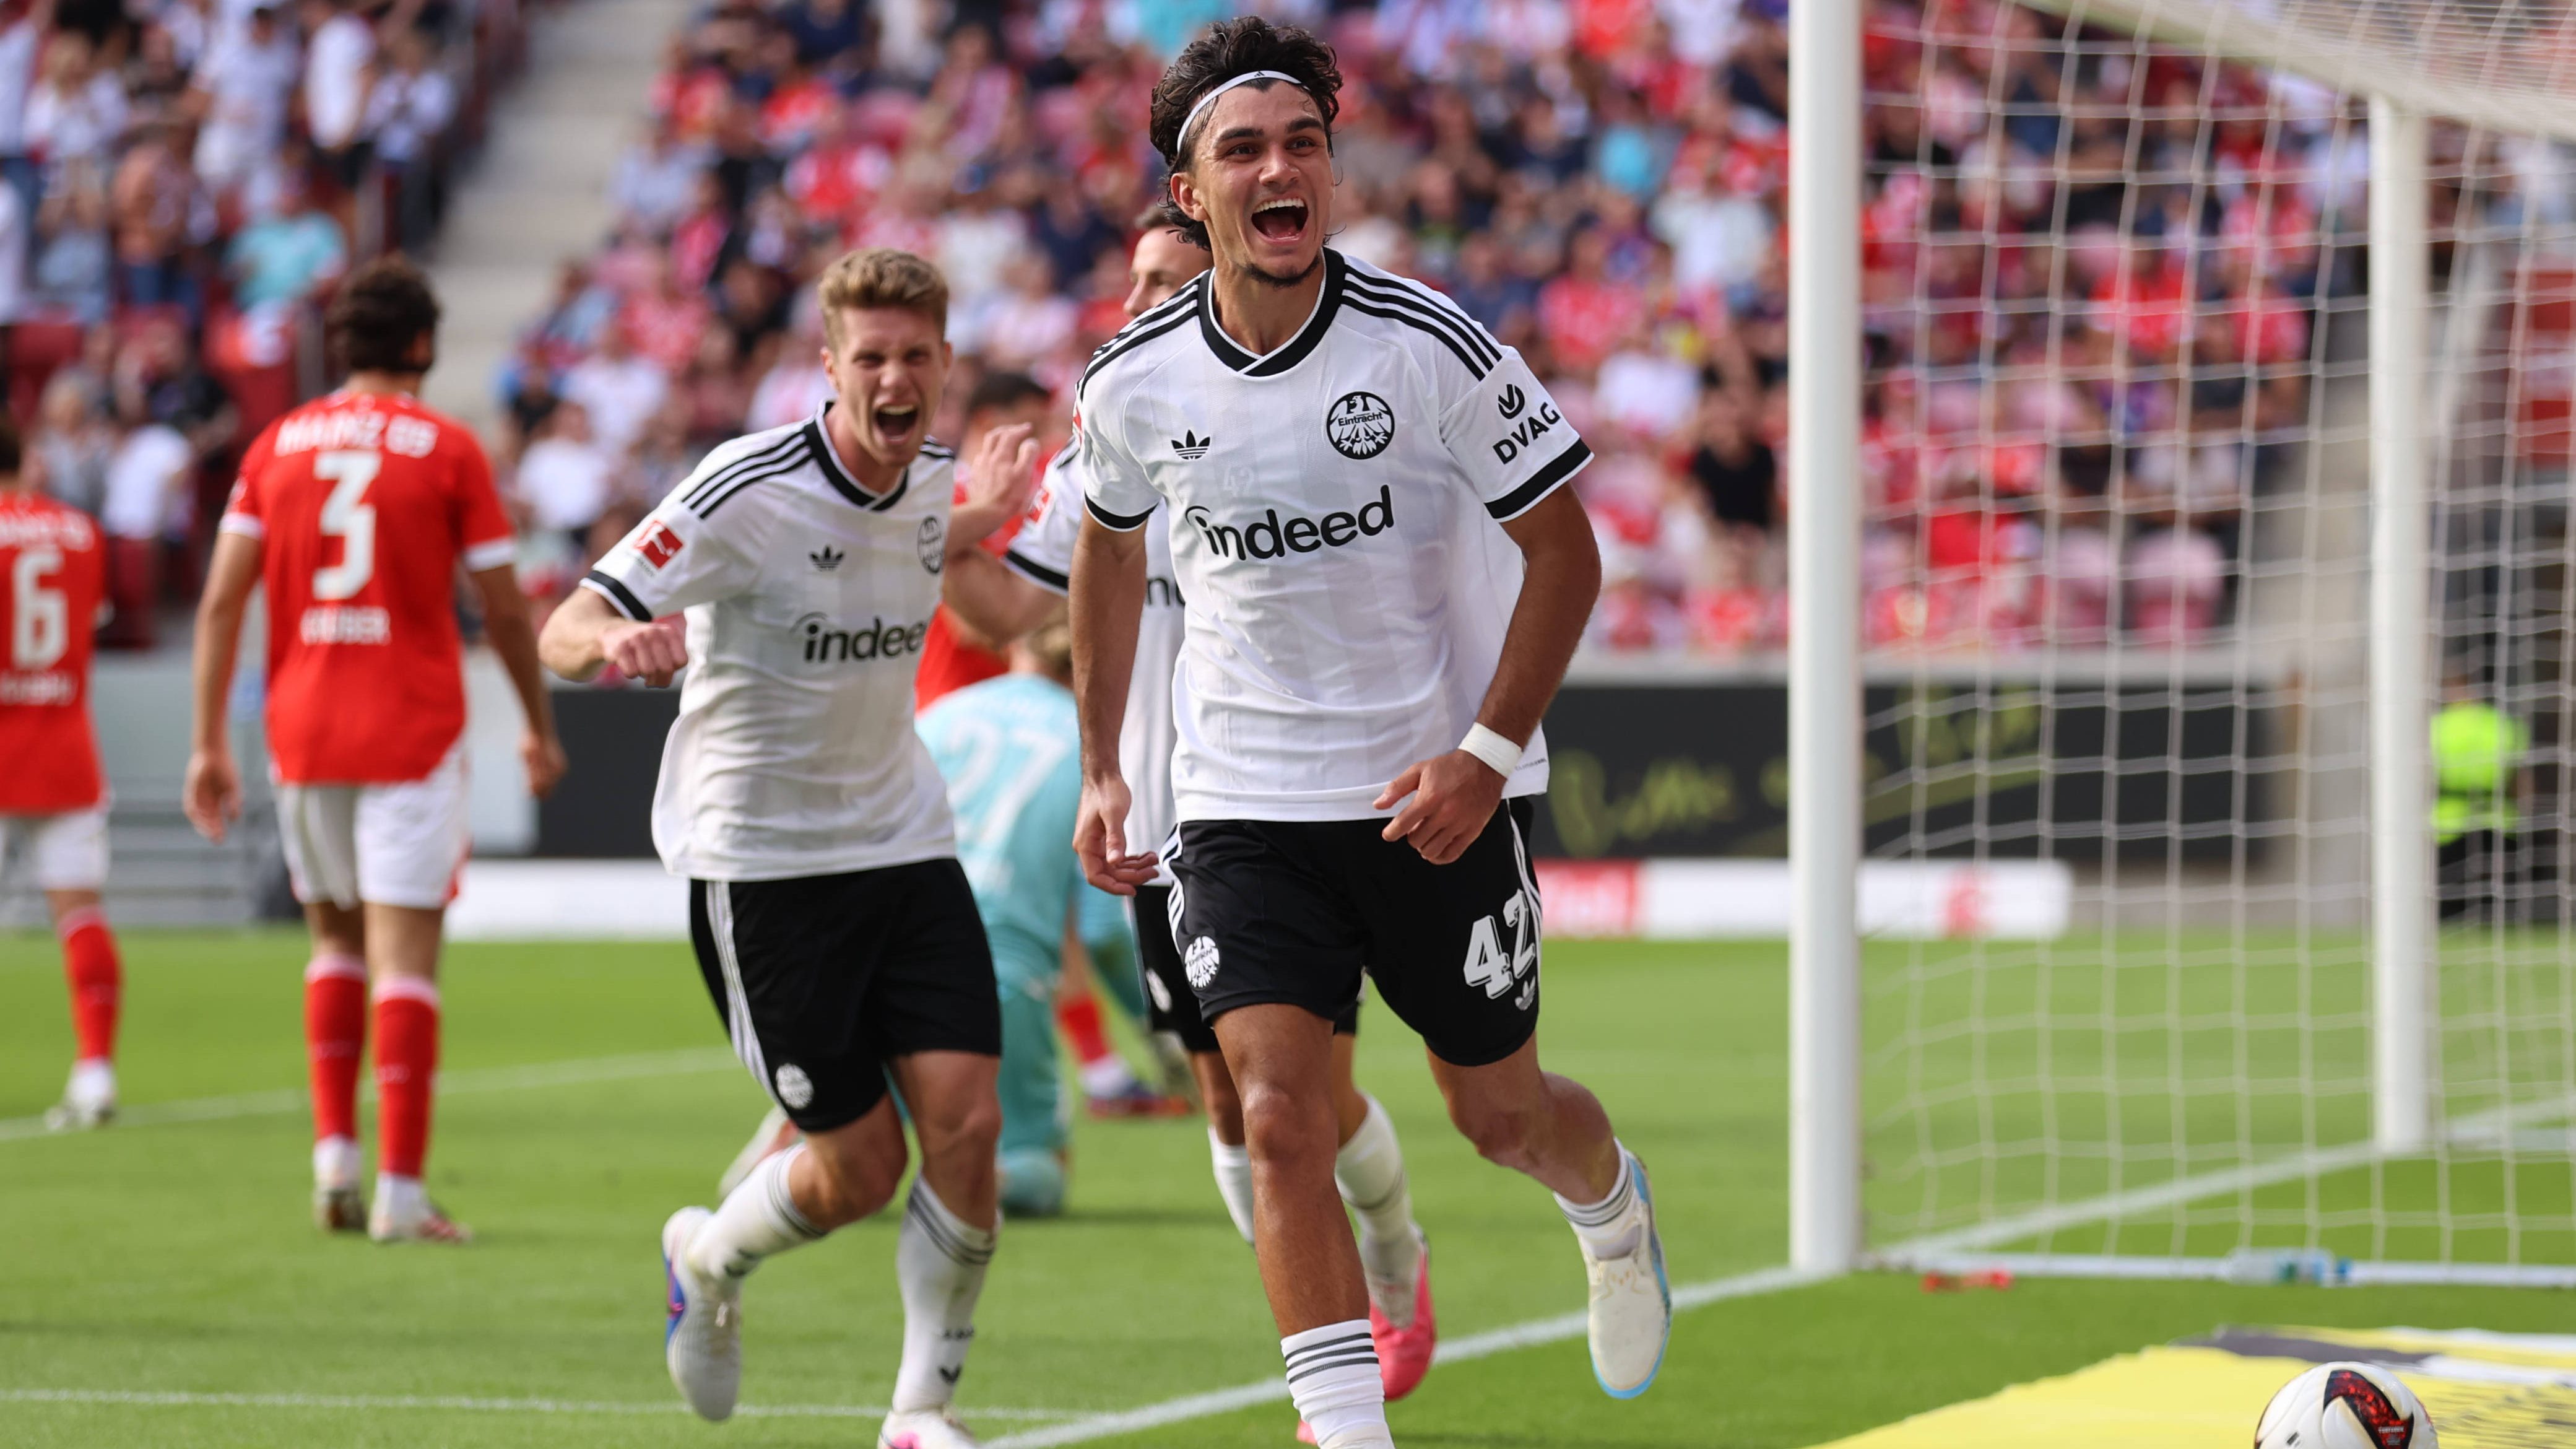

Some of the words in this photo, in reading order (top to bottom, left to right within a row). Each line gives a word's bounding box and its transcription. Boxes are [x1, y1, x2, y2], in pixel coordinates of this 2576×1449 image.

[1338, 412, 1383, 427] Eintracht
[1493, 402, 1561, 464] DVAG
[313, 450, 381, 600] 3
[1185, 484, 1394, 561] indeed
[12, 548, 69, 670] 6
[941, 717, 1072, 847] 27
[1463, 888, 1537, 1000] 42
